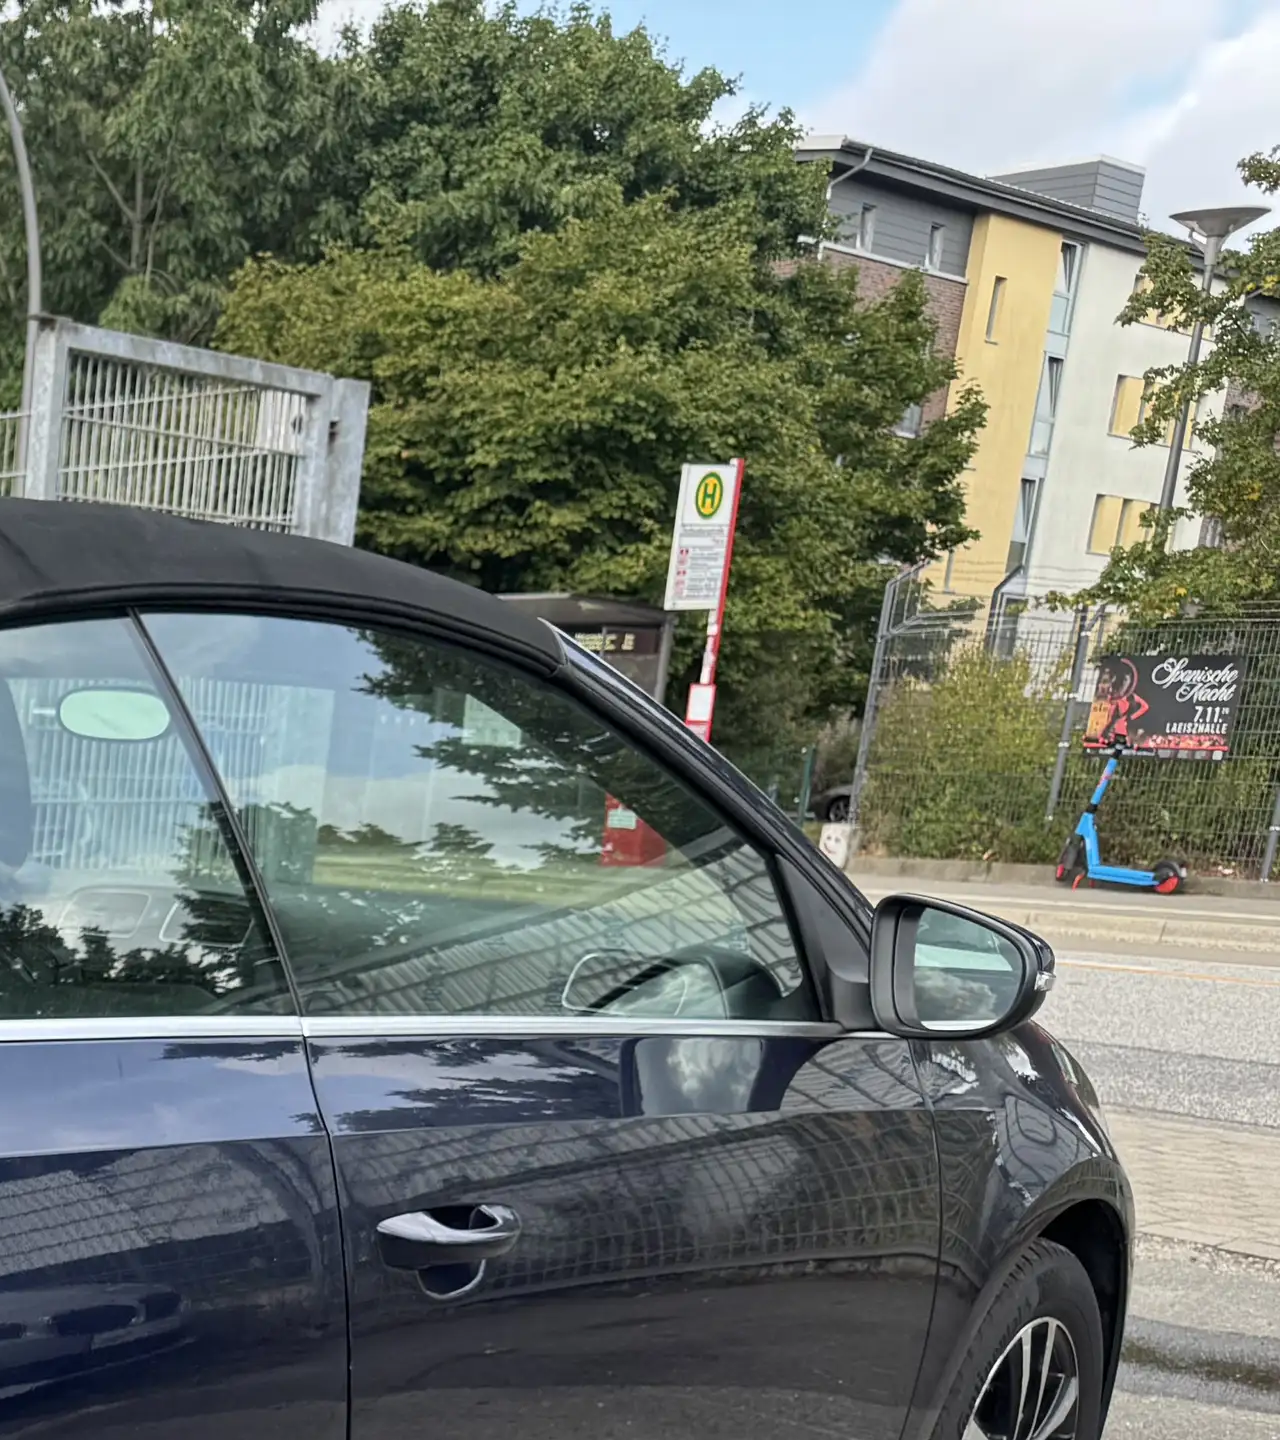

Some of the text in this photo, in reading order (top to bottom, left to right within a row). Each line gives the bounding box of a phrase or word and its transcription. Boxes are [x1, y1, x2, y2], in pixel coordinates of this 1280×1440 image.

[701, 482, 717, 509] H
[1151, 657, 1239, 689] Spanische
[1176, 682, 1238, 703] Nacht
[1165, 722, 1228, 735] LAEISZHALLE
